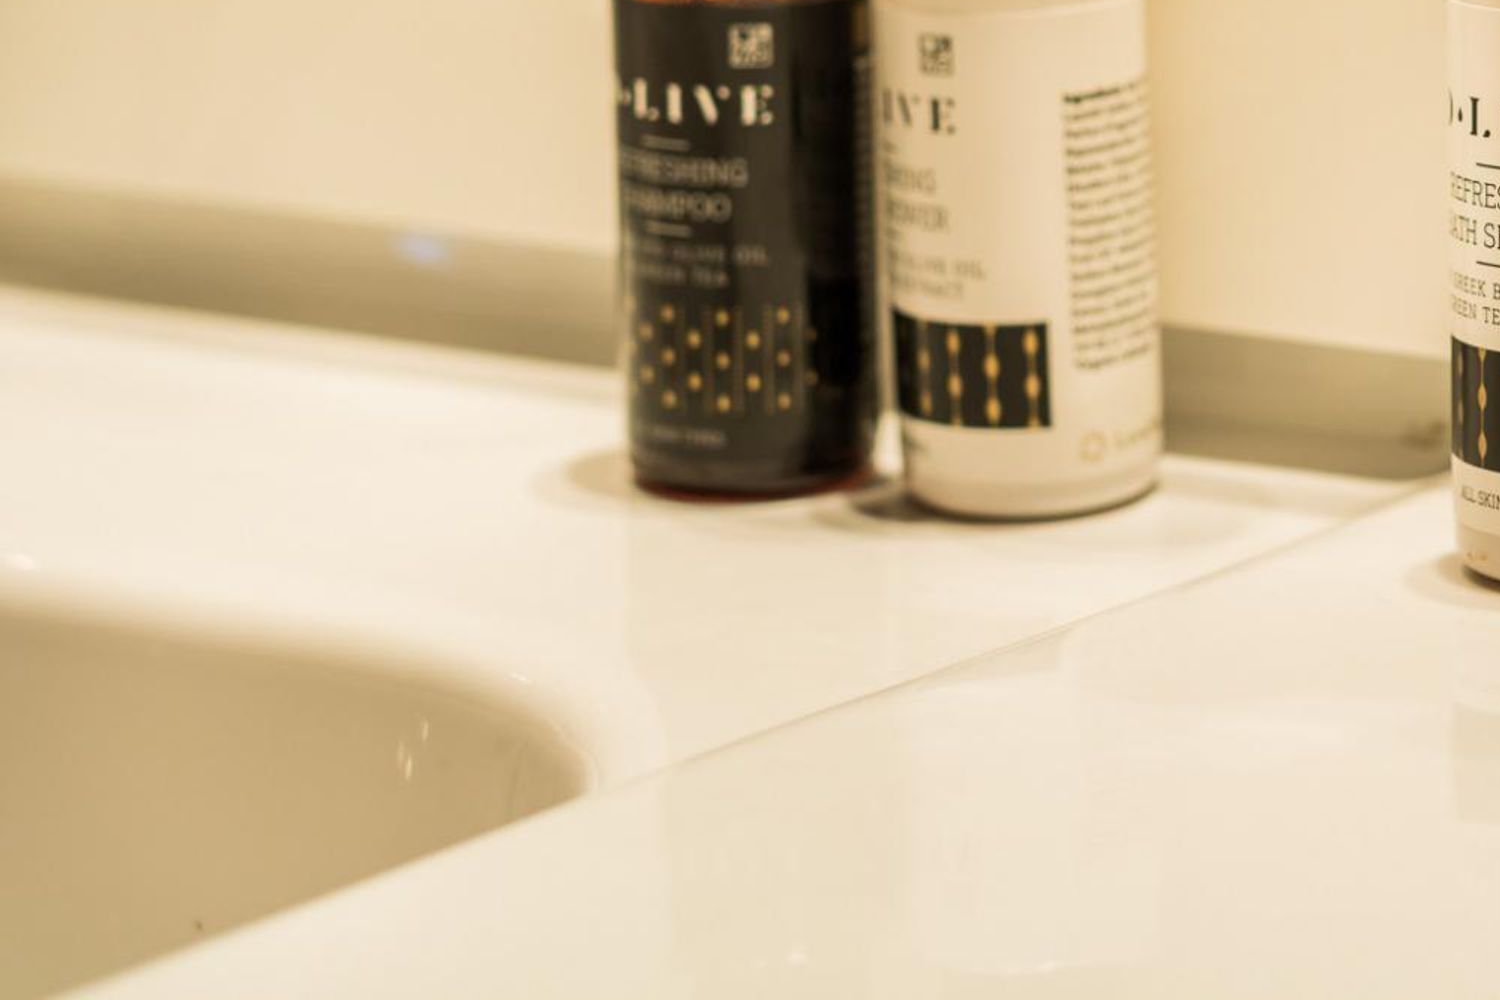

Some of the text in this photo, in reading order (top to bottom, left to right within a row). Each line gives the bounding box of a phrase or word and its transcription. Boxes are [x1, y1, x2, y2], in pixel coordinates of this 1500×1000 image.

[1450, 211, 1478, 246] ATH
[1452, 271, 1487, 298] REEK
[1451, 293, 1477, 320] REEN
